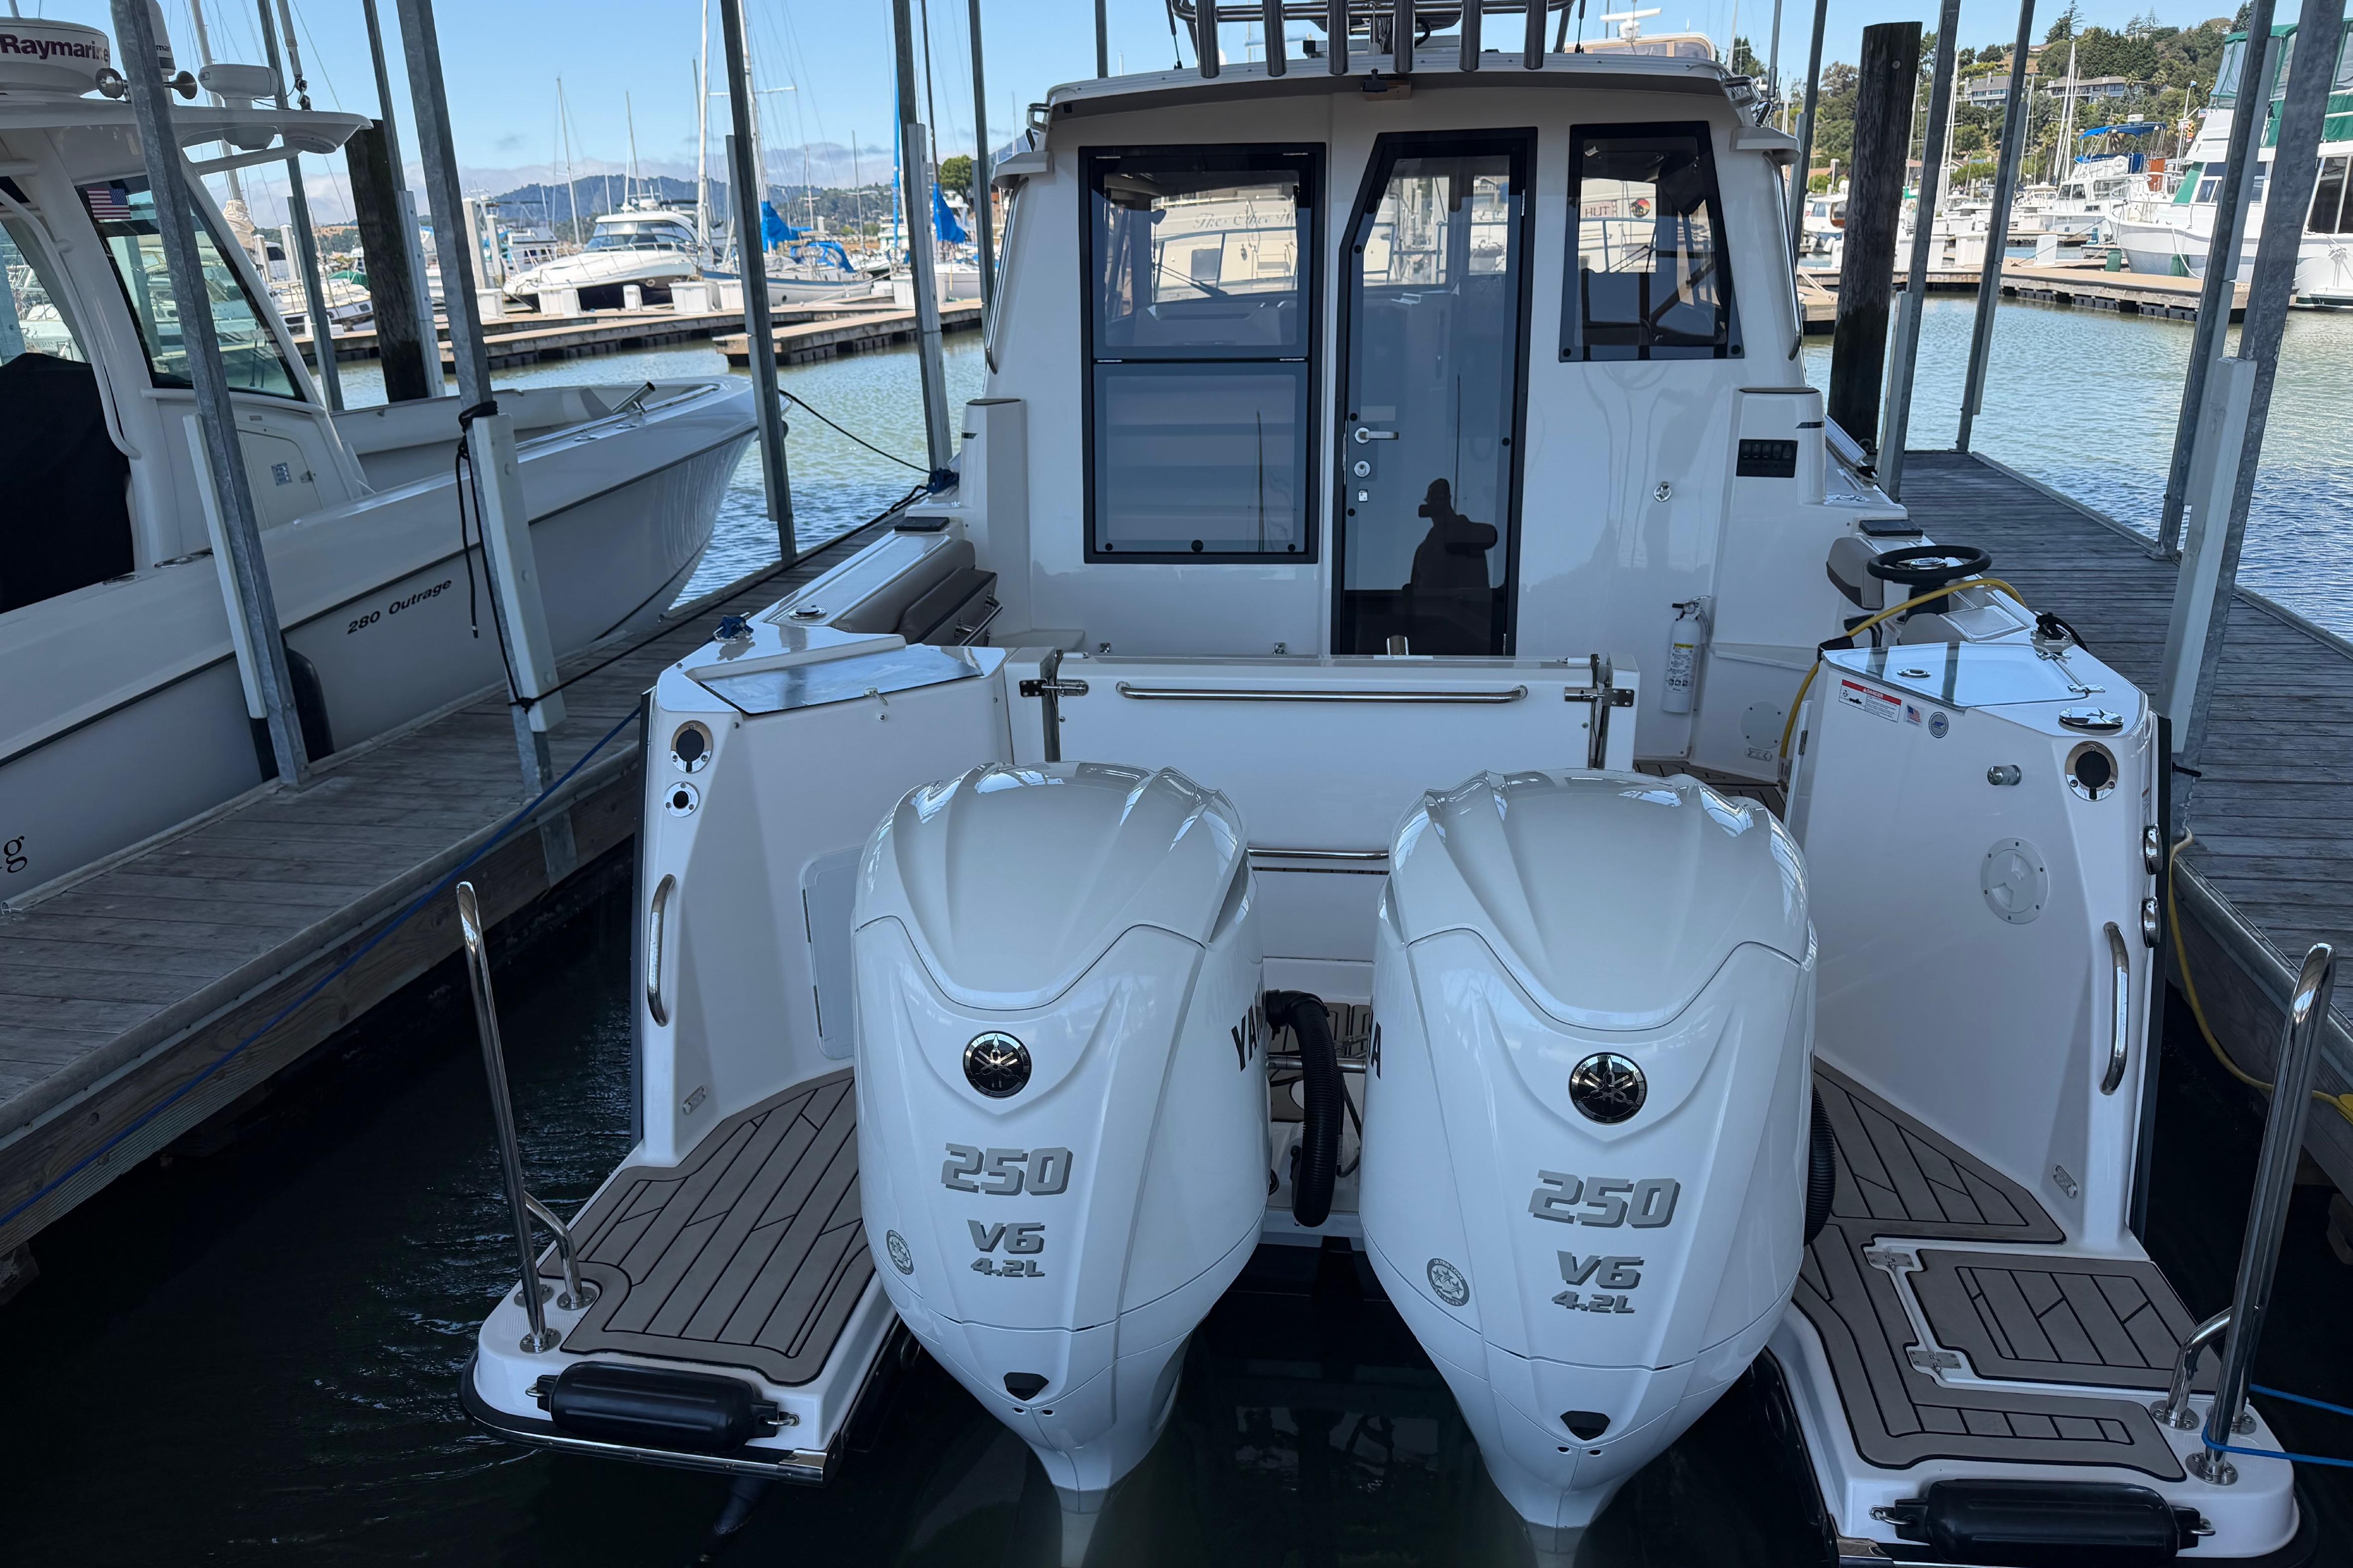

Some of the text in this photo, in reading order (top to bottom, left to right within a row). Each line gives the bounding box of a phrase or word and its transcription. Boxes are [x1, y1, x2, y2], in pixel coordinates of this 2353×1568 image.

[1585, 205, 1610, 217] HUT
[347, 580, 452, 635] 280 Outrage
[1867, 688, 1883, 698] DANGER
[940, 1142, 1073, 1196] 250
[1528, 1169, 1681, 1229] 250
[967, 1218, 1045, 1255] V6
[970, 1257, 1045, 1277] 4.2L
[1556, 1249, 1645, 1289] V6
[1551, 1290, 1636, 1314] 4.2L
